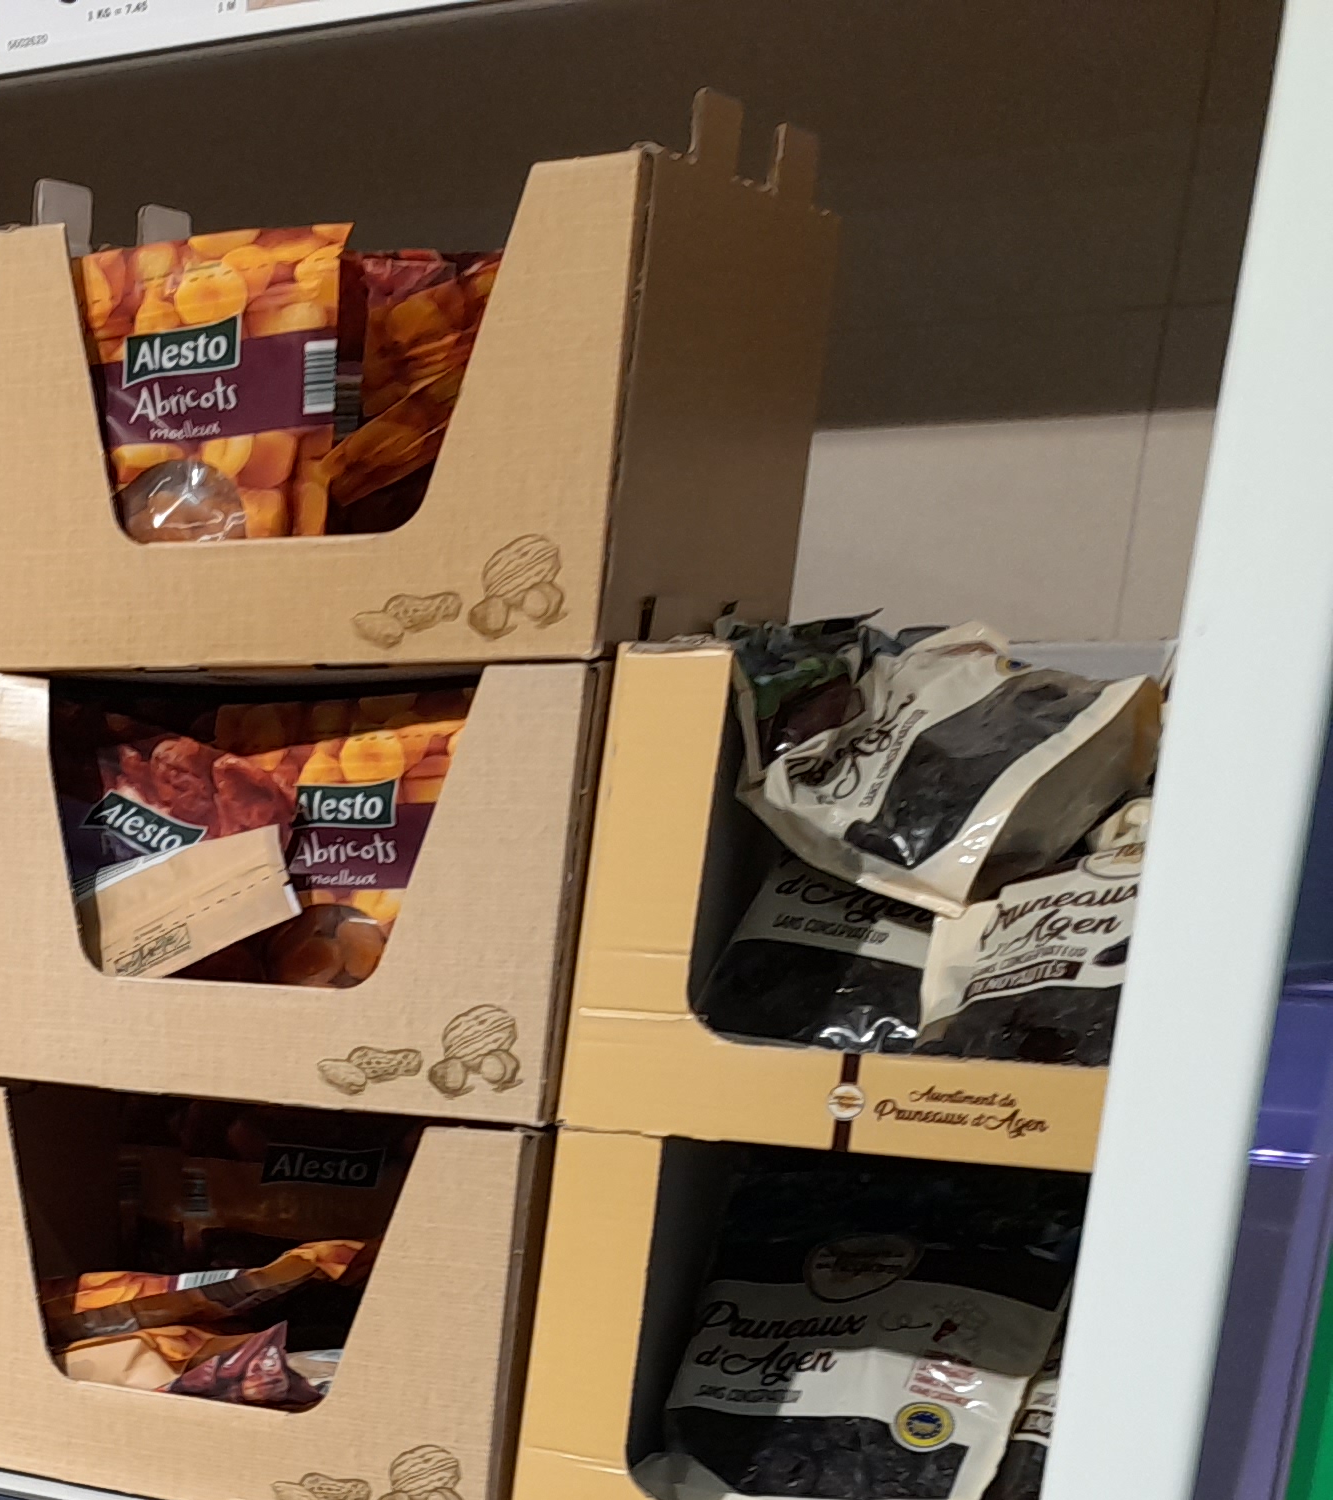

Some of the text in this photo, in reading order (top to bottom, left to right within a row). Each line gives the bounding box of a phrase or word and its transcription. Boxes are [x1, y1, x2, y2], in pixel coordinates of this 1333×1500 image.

[134, 331, 228, 374] Alesto
[130, 377, 238, 424] Abricots
[295, 789, 383, 822] Alesto
[100, 802, 183, 851] Alesto
[294, 830, 397, 869] Abricots
[305, 870, 377, 888] moelleux
[874, 1099, 968, 1126] Pruneaux
[271, 1152, 368, 1182] Alesto
[698, 1300, 868, 1341] Pruneaux
[695, 1341, 840, 1386] d'Agen
